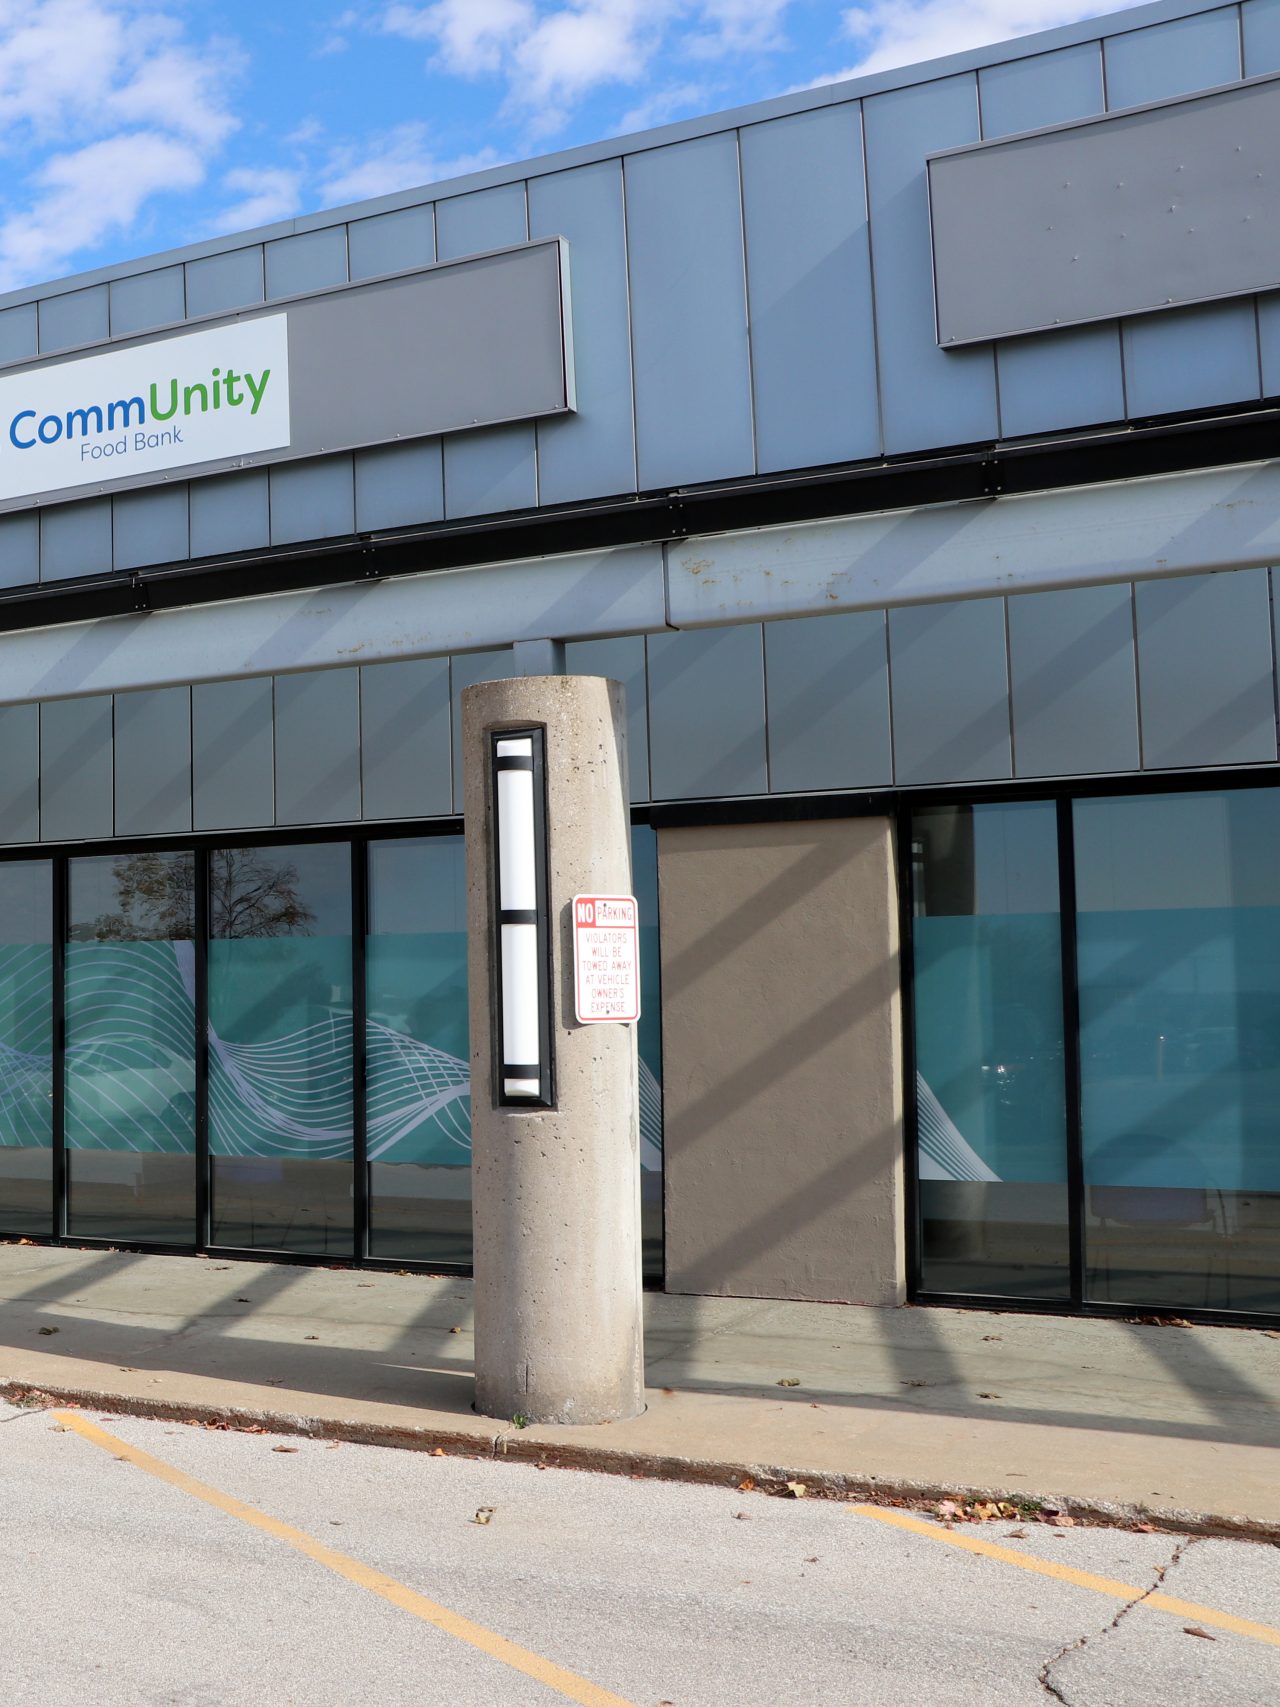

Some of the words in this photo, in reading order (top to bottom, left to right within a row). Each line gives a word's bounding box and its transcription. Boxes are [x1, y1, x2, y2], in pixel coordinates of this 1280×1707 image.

[9, 368, 271, 449] CommUnity
[81, 436, 128, 462] Food
[134, 425, 184, 451] Bank
[578, 903, 594, 923] NO
[597, 906, 632, 921] PARKING
[586, 933, 627, 943] VIOLATORS
[592, 947, 609, 957] WILL
[612, 947, 622, 957] BE
[582, 961, 608, 971] TOWED
[611, 961, 632, 971] AWAY
[586, 975, 595, 984] AT
[598, 974, 630, 984] VEHICLE
[591, 1001, 625, 1012] EXPENSE
